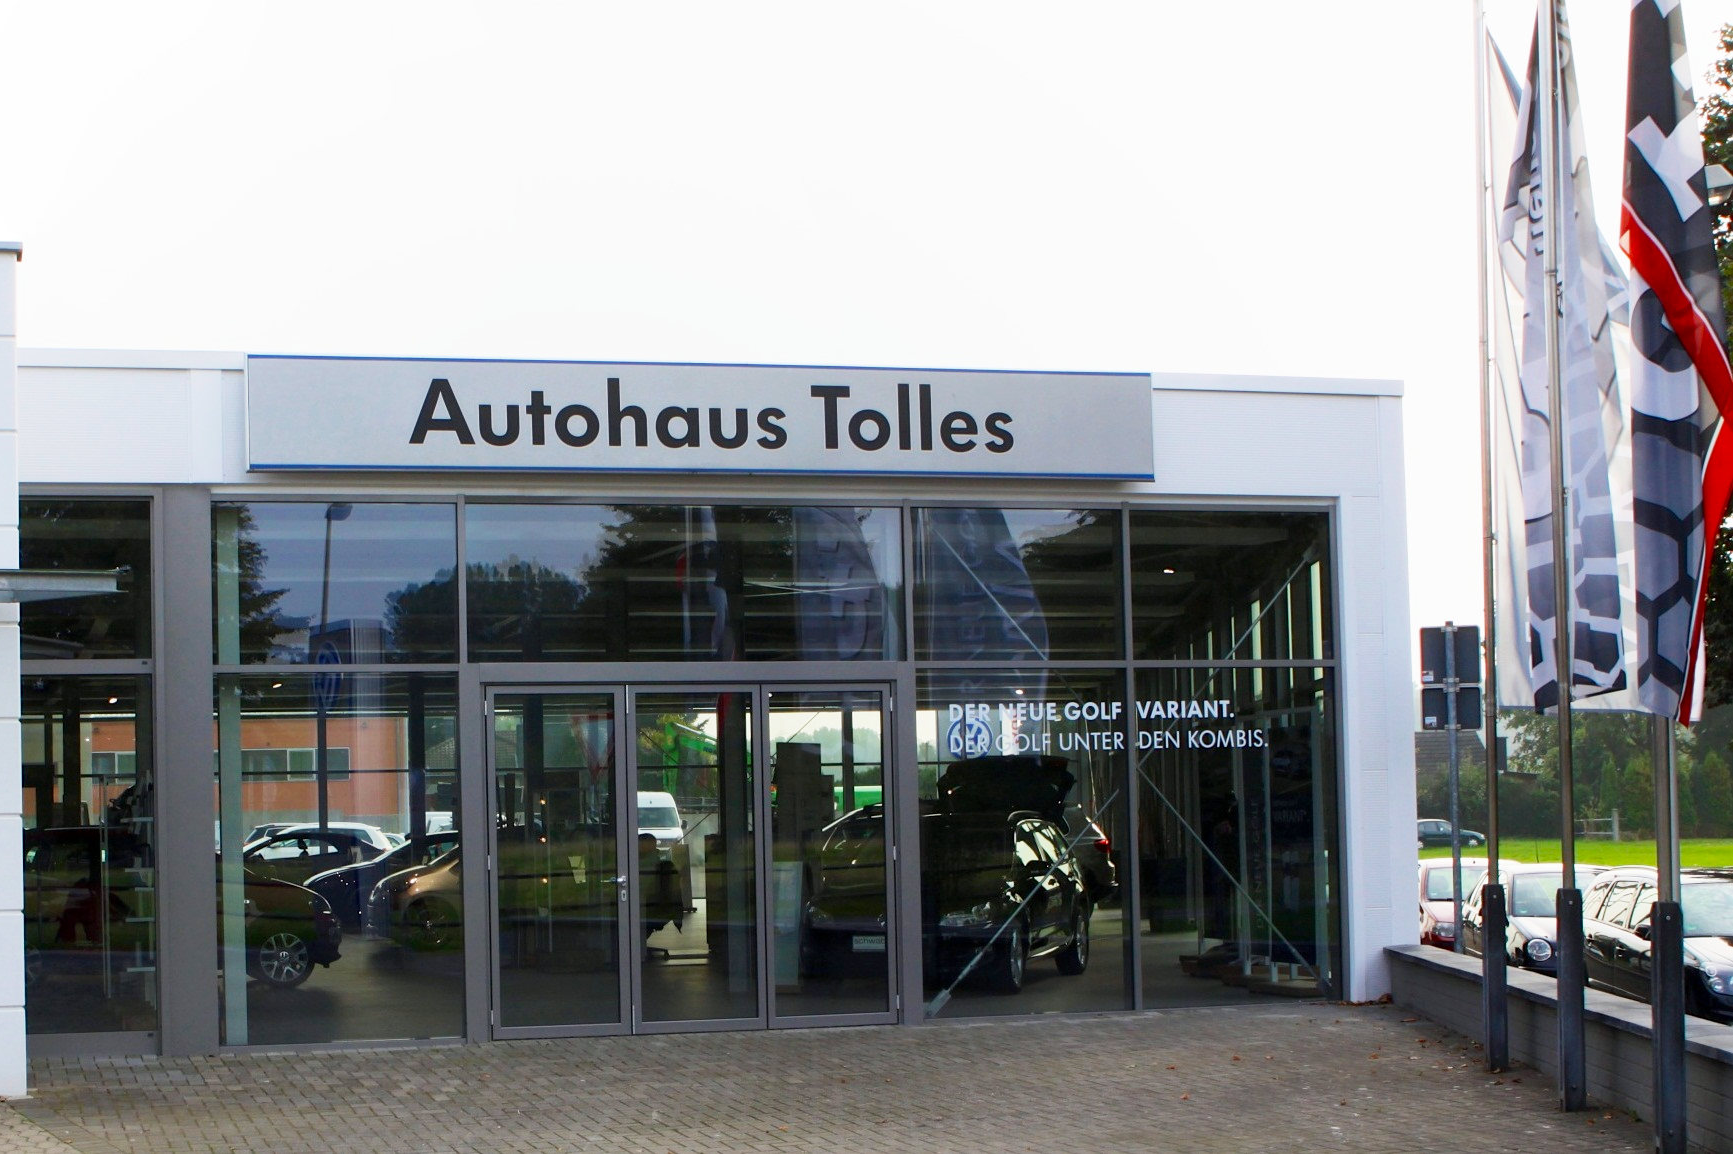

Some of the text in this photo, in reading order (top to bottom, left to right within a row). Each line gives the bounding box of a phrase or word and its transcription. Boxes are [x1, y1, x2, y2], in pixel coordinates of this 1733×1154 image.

[409, 377, 1014, 453] Autohaus Tolles
[949, 699, 1235, 722] DER NEUE GOLF VARIANT.
[950, 728, 1269, 753] DER GOLF UNTER DEN KOMBIS.
